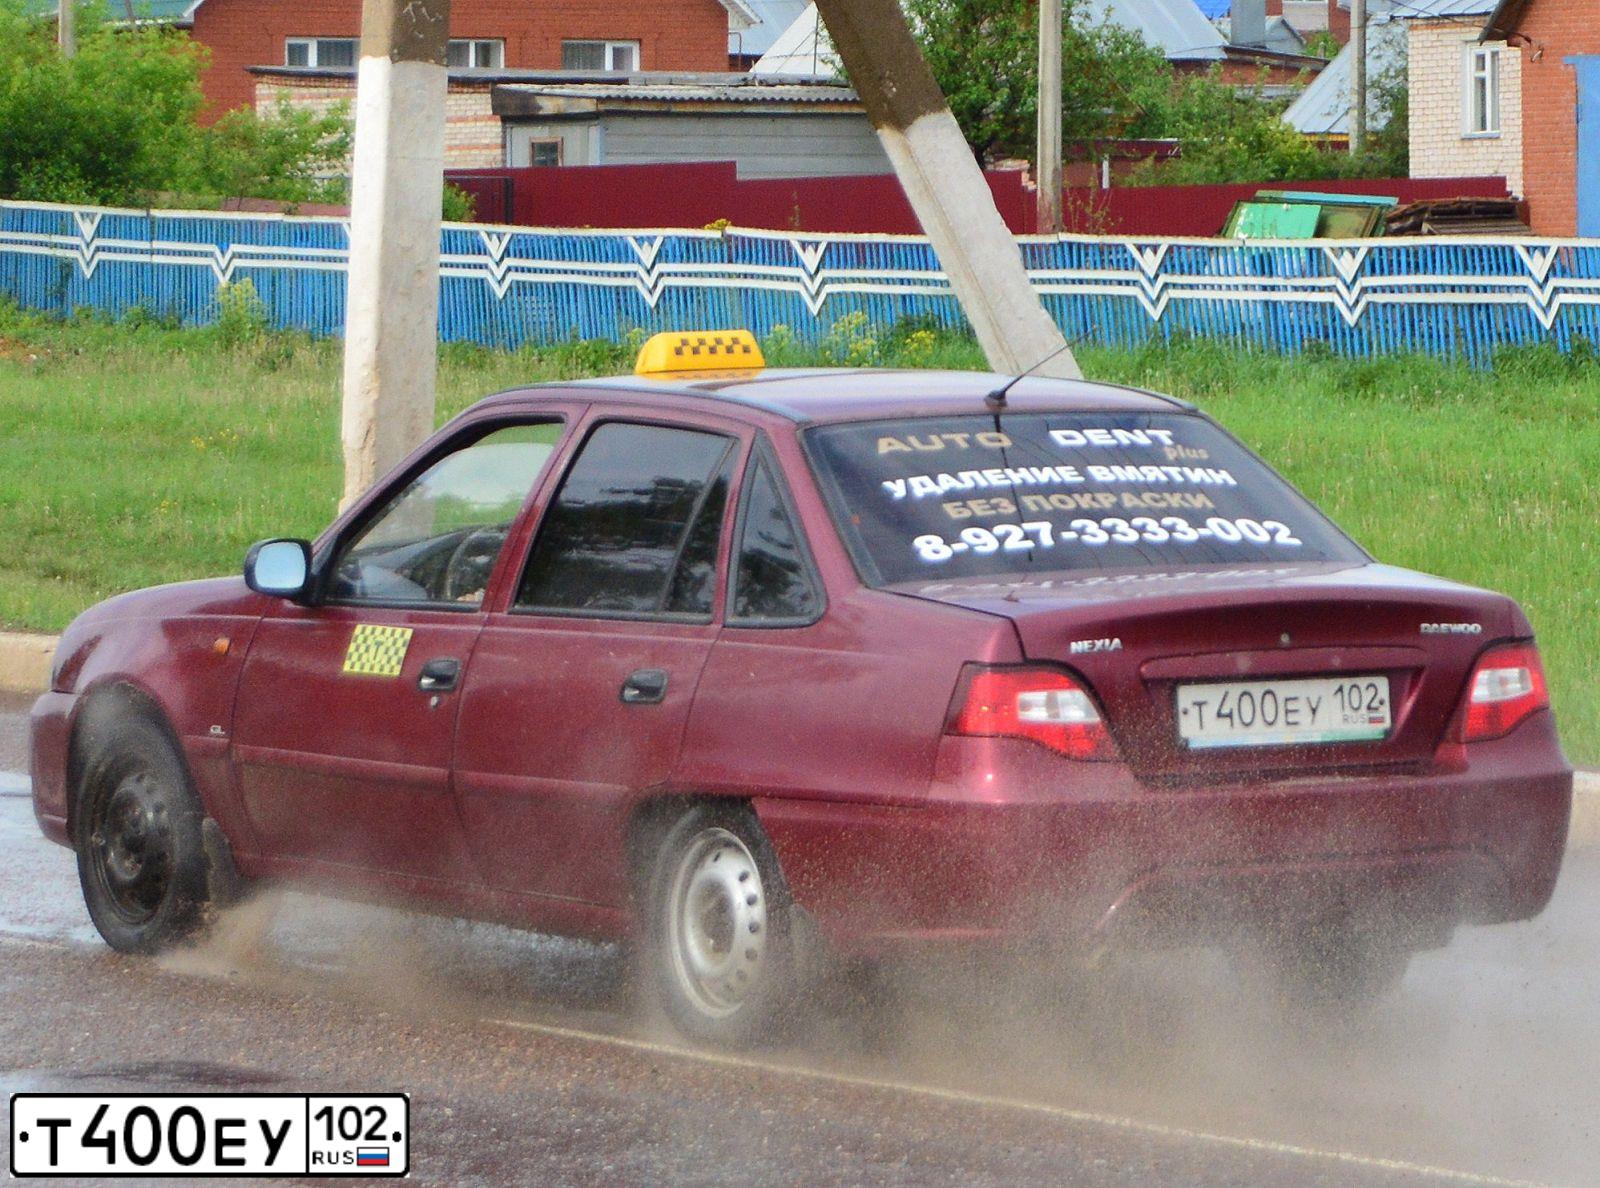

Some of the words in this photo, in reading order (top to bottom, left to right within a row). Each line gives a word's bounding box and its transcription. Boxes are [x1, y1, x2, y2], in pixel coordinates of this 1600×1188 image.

[877, 431, 1013, 454] AUTO
[1049, 428, 1175, 448] DENT
[1163, 444, 1209, 462] plus
[880, 465, 1085, 500] УДАЛЕНИЕ
[1086, 465, 1238, 486] ВМЯТИН
[942, 497, 1017, 519] БЕЗ
[1020, 492, 1214, 512] ПОКРАСКИ
[912, 516, 1303, 563] 8-927-3333-002
[1070, 637, 1123, 654] NEXIA
[1333, 682, 1381, 713] 102
[1342, 714, 1367, 725] RUS
